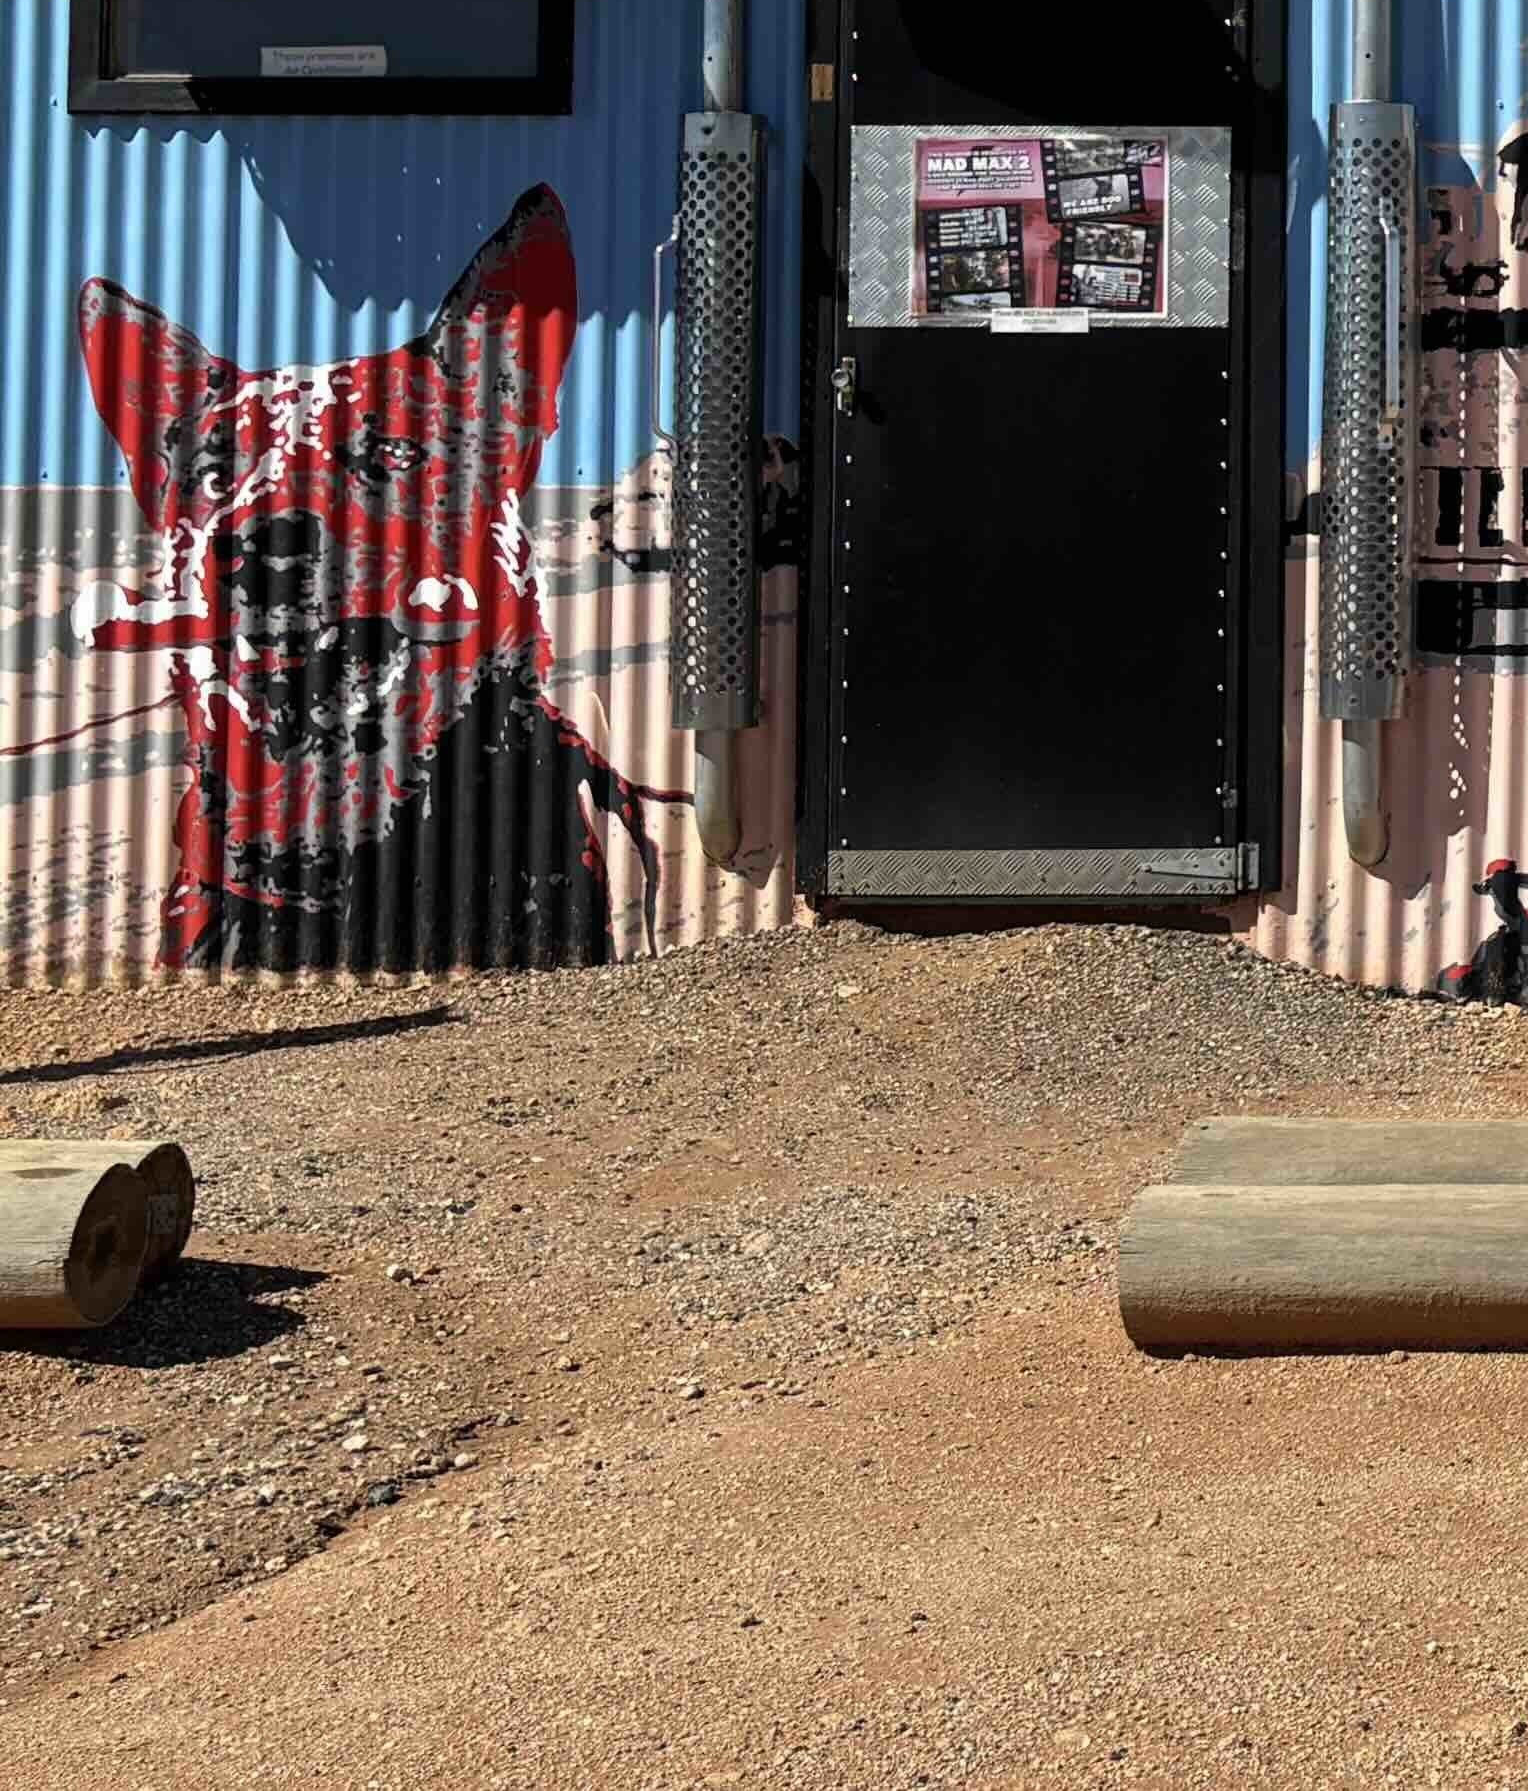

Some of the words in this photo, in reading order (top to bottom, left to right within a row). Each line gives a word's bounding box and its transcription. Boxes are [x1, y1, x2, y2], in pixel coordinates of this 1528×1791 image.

[927, 158, 967, 171] MAD
[972, 157, 1013, 171] MAX
[1018, 155, 1030, 169] 2
